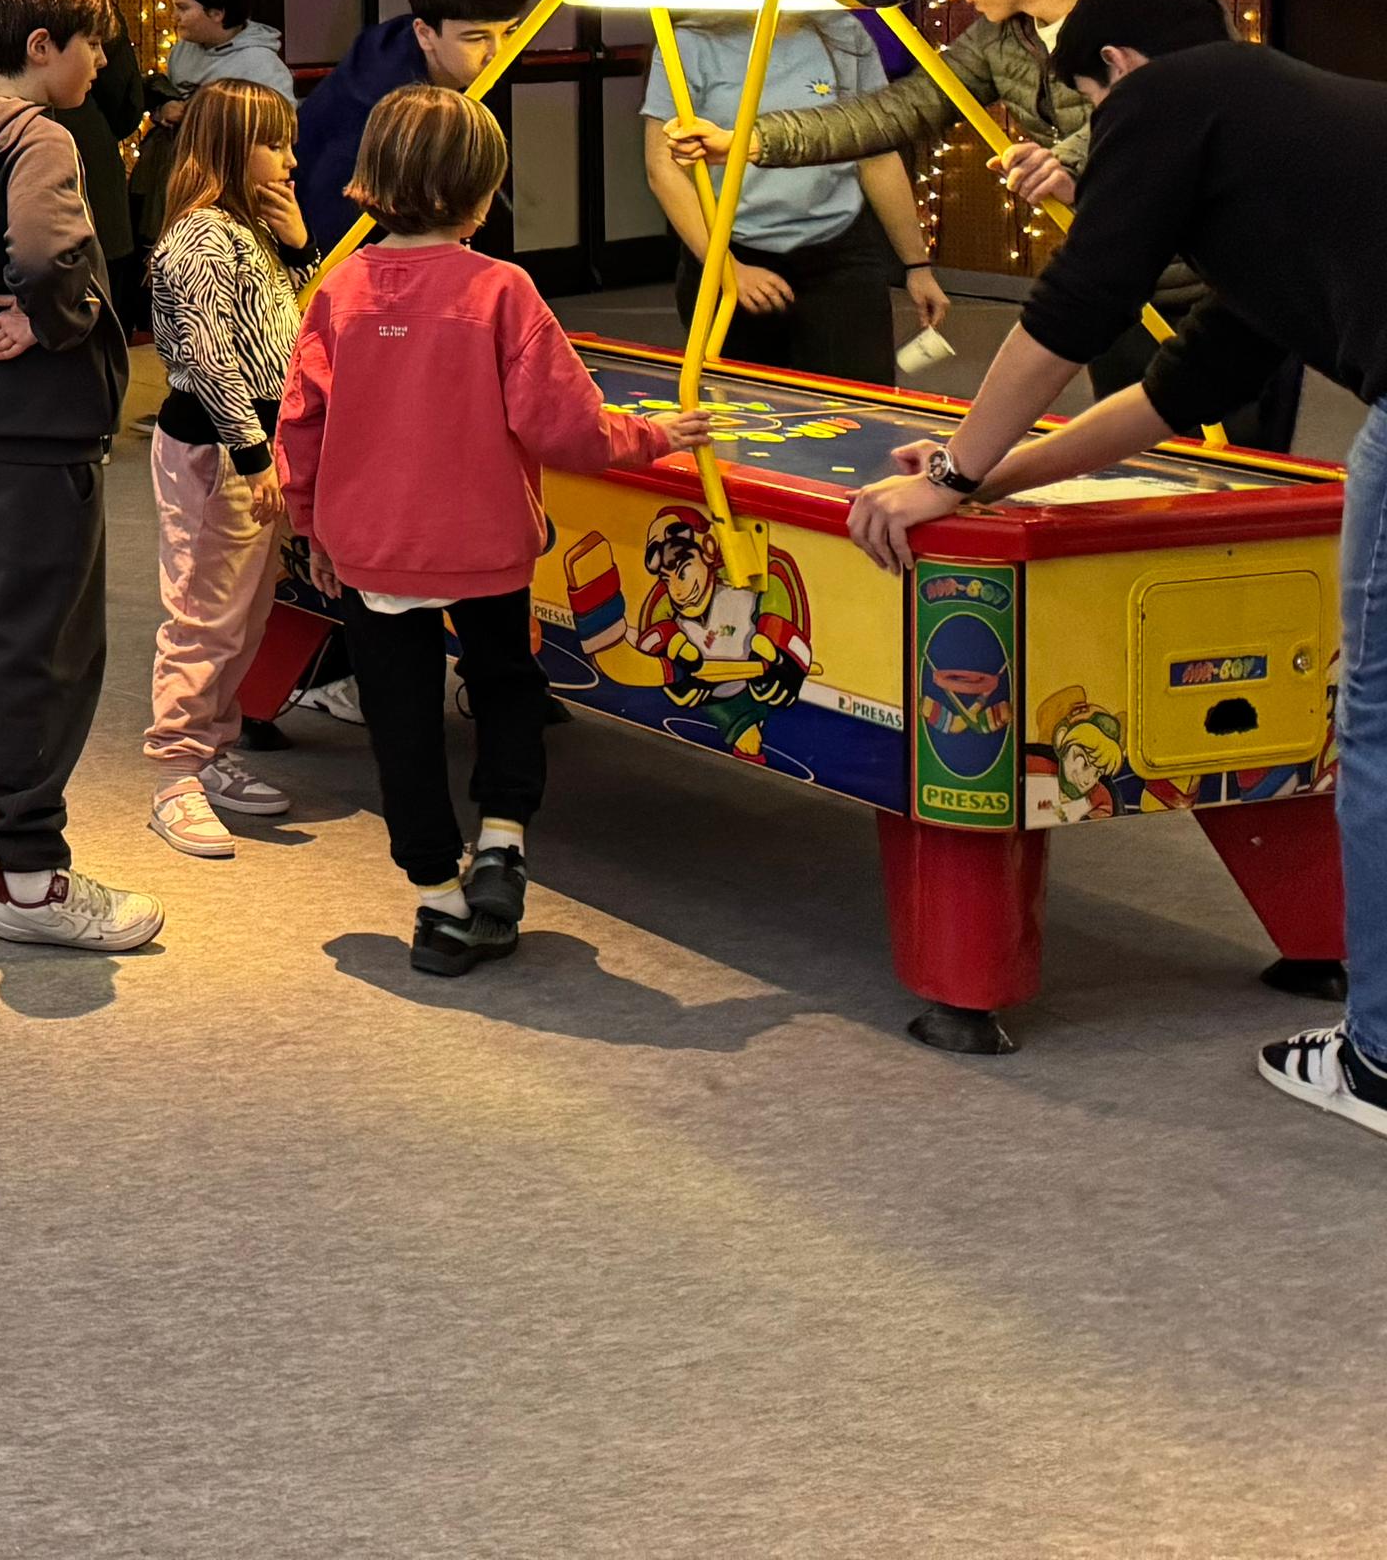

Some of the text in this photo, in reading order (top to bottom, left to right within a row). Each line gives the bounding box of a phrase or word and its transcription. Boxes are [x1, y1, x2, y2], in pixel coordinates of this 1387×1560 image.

[533, 605, 573, 627] PRESAS
[852, 701, 903, 728] PRESAS
[927, 787, 1007, 811] PRESAS
